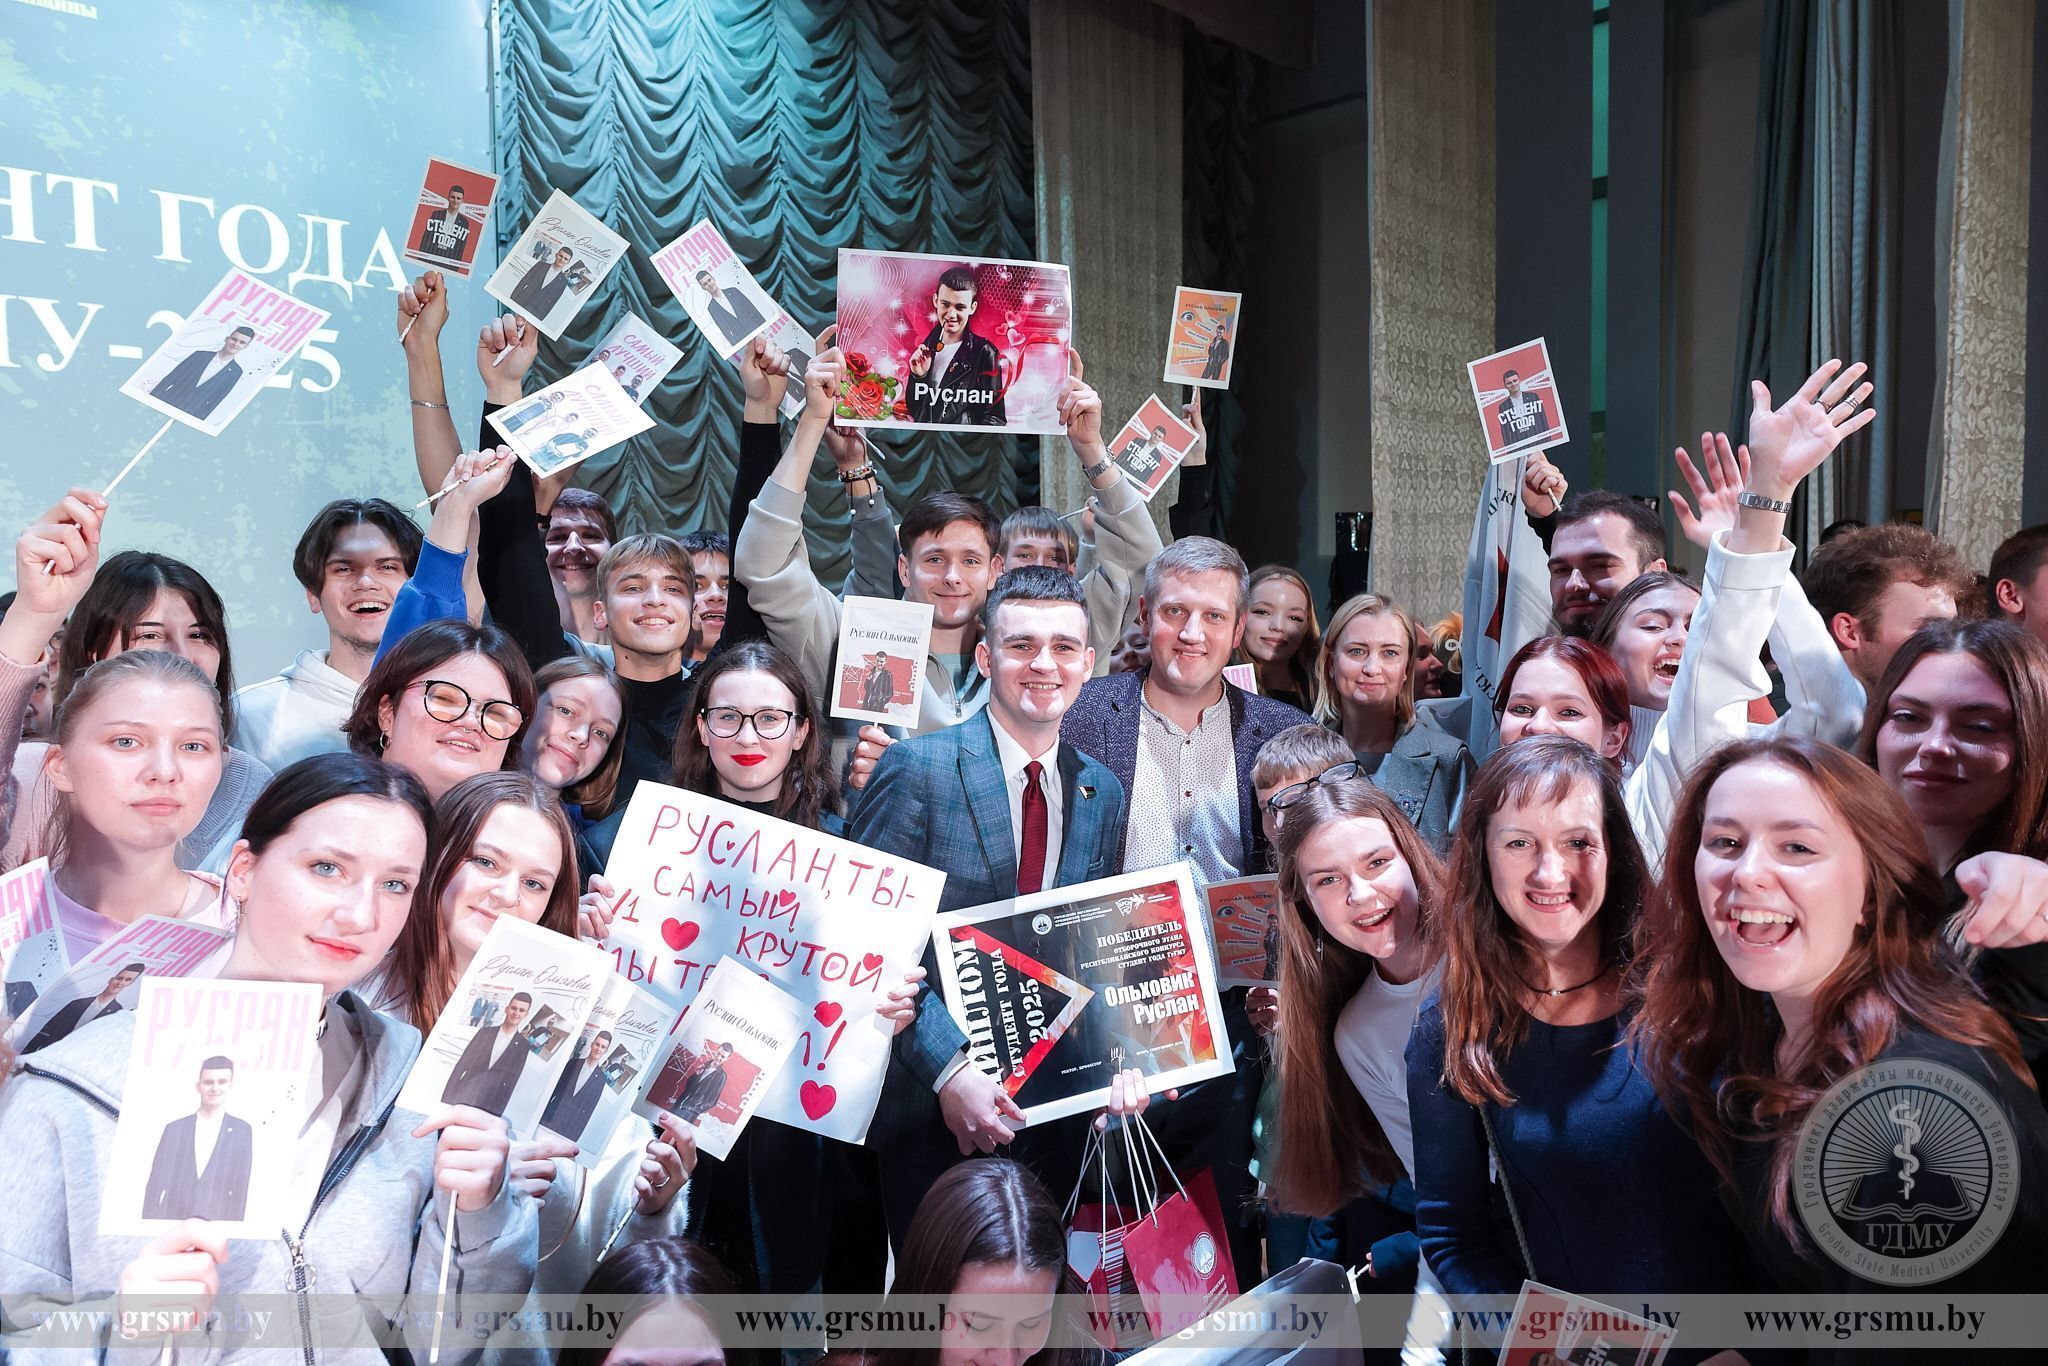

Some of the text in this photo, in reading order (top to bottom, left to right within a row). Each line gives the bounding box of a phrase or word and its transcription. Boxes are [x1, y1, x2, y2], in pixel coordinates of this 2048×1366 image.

[150, 189, 411, 302] ГОДА
[607, 345, 658, 381] ЛУЧШИЙ
[623, 334, 667, 367] САМЫЙ
[914, 382, 994, 407] Руслан
[653, 865, 801, 927] САМЫЙ
[1096, 920, 1183, 948] ПОБЕДИТЕЛЬ
[1113, 933, 1183, 954] ОТБОРОЧНОГО ЭТАПА
[735, 925, 884, 993] КРУТОЙ
[1080, 941, 1185, 970] РЕСПУБЛИКАНСКОГО КОНКУРСА
[1117, 957, 1147, 969] СТУДЕНТ
[1148, 954, 1166, 963] ГОДА
[989, 947, 1027, 1078] СТУДЕНТ ГОДА
[1018, 978, 1049, 1044] 2025
[1132, 993, 1200, 1025] Руслан
